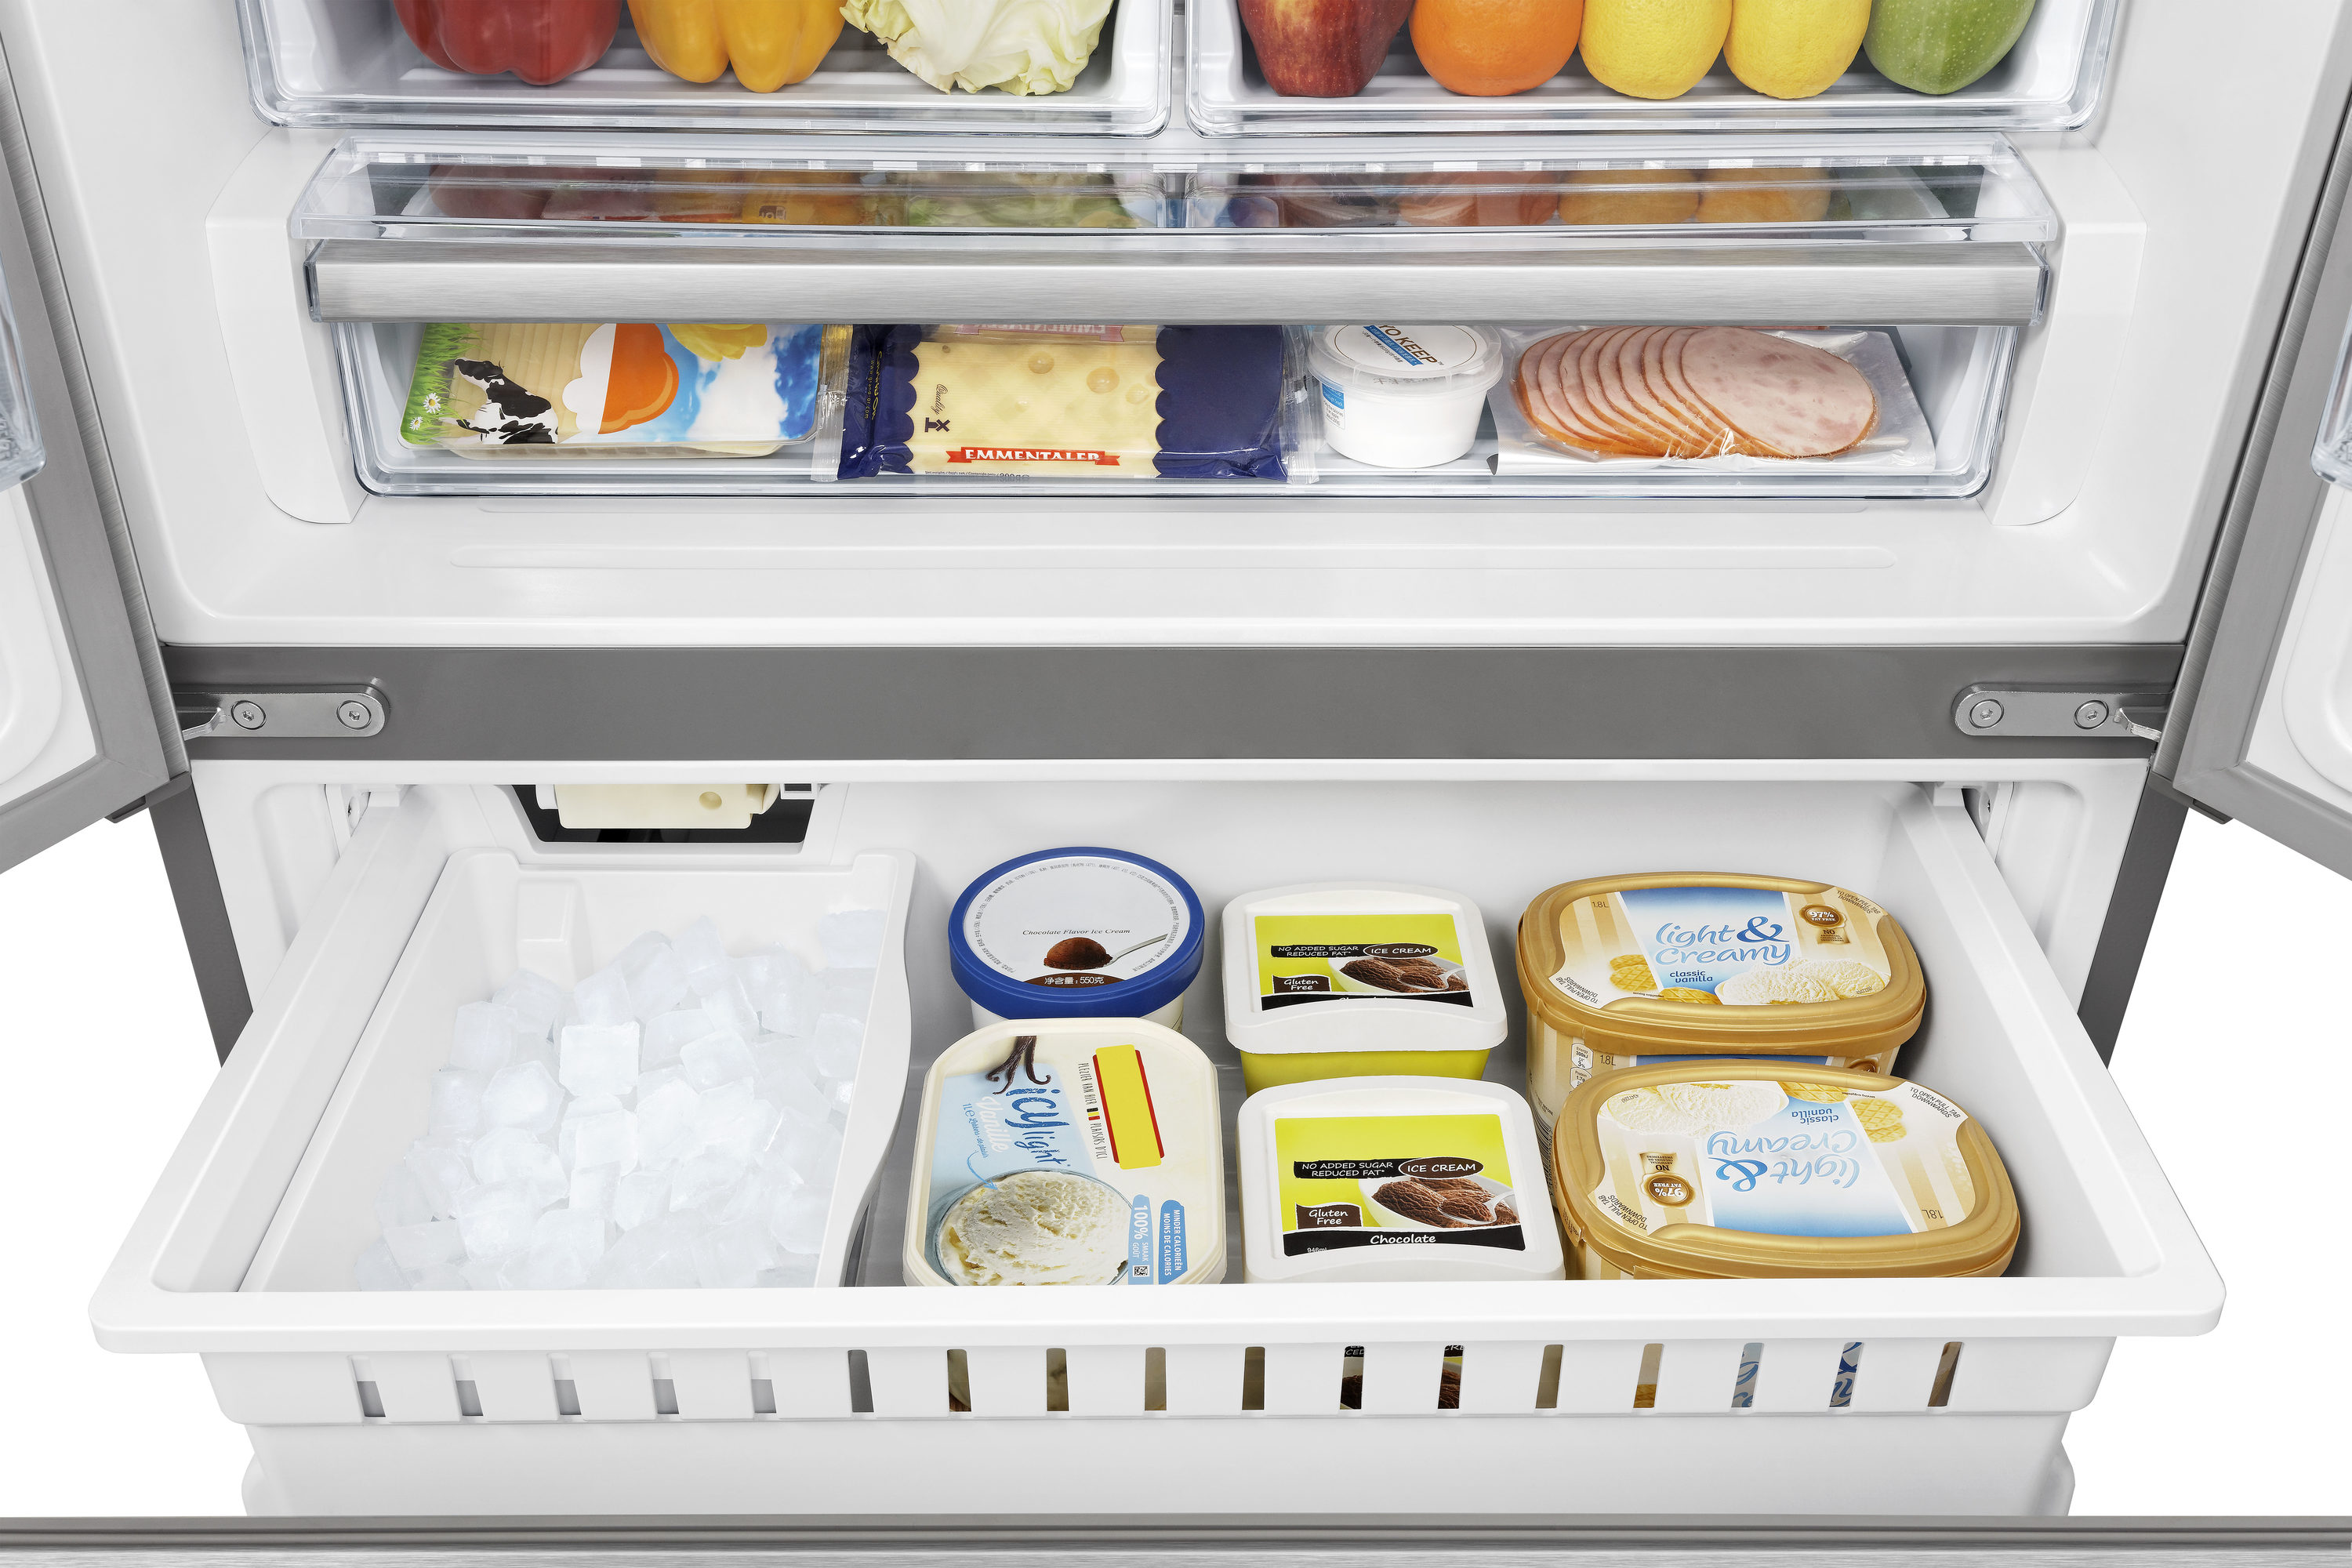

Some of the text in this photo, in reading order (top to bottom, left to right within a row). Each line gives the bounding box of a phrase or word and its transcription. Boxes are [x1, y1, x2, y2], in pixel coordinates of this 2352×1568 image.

[1395, 337, 1437, 363] KEEP
[931, 383, 948, 416] Quality
[965, 449, 1100, 461] EMMENTALER
[1845, 893, 1860, 902] OPEN
[1656, 916, 1790, 948] light &
[1392, 946, 1432, 955] CREAM
[1655, 944, 1791, 966] Creamy
[1284, 978, 1319, 986] Gluten
[1564, 976, 1599, 998] DOWNWARDS
[1565, 983, 1577, 993] PULL
[1577, 990, 1591, 1001] OPEN
[1600, 1054, 1617, 1066] 1.8L
[1078, 1062, 1098, 1105] PLEZIER VAN HIER
[1911, 1093, 1953, 1119] DOWNWARDS
[1918, 1091, 1937, 1102] OPEN
[1935, 1098, 1951, 1110] PULL
[1948, 1109, 1961, 1119] TAB
[1791, 1108, 1832, 1119] vanilla
[977, 1096, 1012, 1153] Vanille
[1800, 1115, 1839, 1125] classic
[1091, 1123, 1108, 1160] PLAISIRS D'ICI
[1707, 1130, 1857, 1156] Creamy
[1407, 1163, 1475, 1173] ICE CREAM
[1708, 1153, 1860, 1192] light &
[1654, 1188, 1684, 1197] 97%
[1598, 1195, 1610, 1206] TAB
[1308, 1209, 1348, 1218] Gluten
[1607, 1195, 1647, 1223] DOWNWARDS
[1608, 1205, 1624, 1217] PULL
[1922, 1209, 1944, 1219] 1.8L
[1134, 1205, 1149, 1240] 100%
[1317, 1217, 1342, 1225] Free
[1621, 1214, 1639, 1226] OPEN
[1163, 1235, 1171, 1244] DE
[1173, 1209, 1183, 1271] MINDER CALORIEËN
[1370, 1234, 1436, 1244] Chocolate
[1132, 1242, 1141, 1258] GOÛT
[1163, 1245, 1172, 1276] CALORIES
